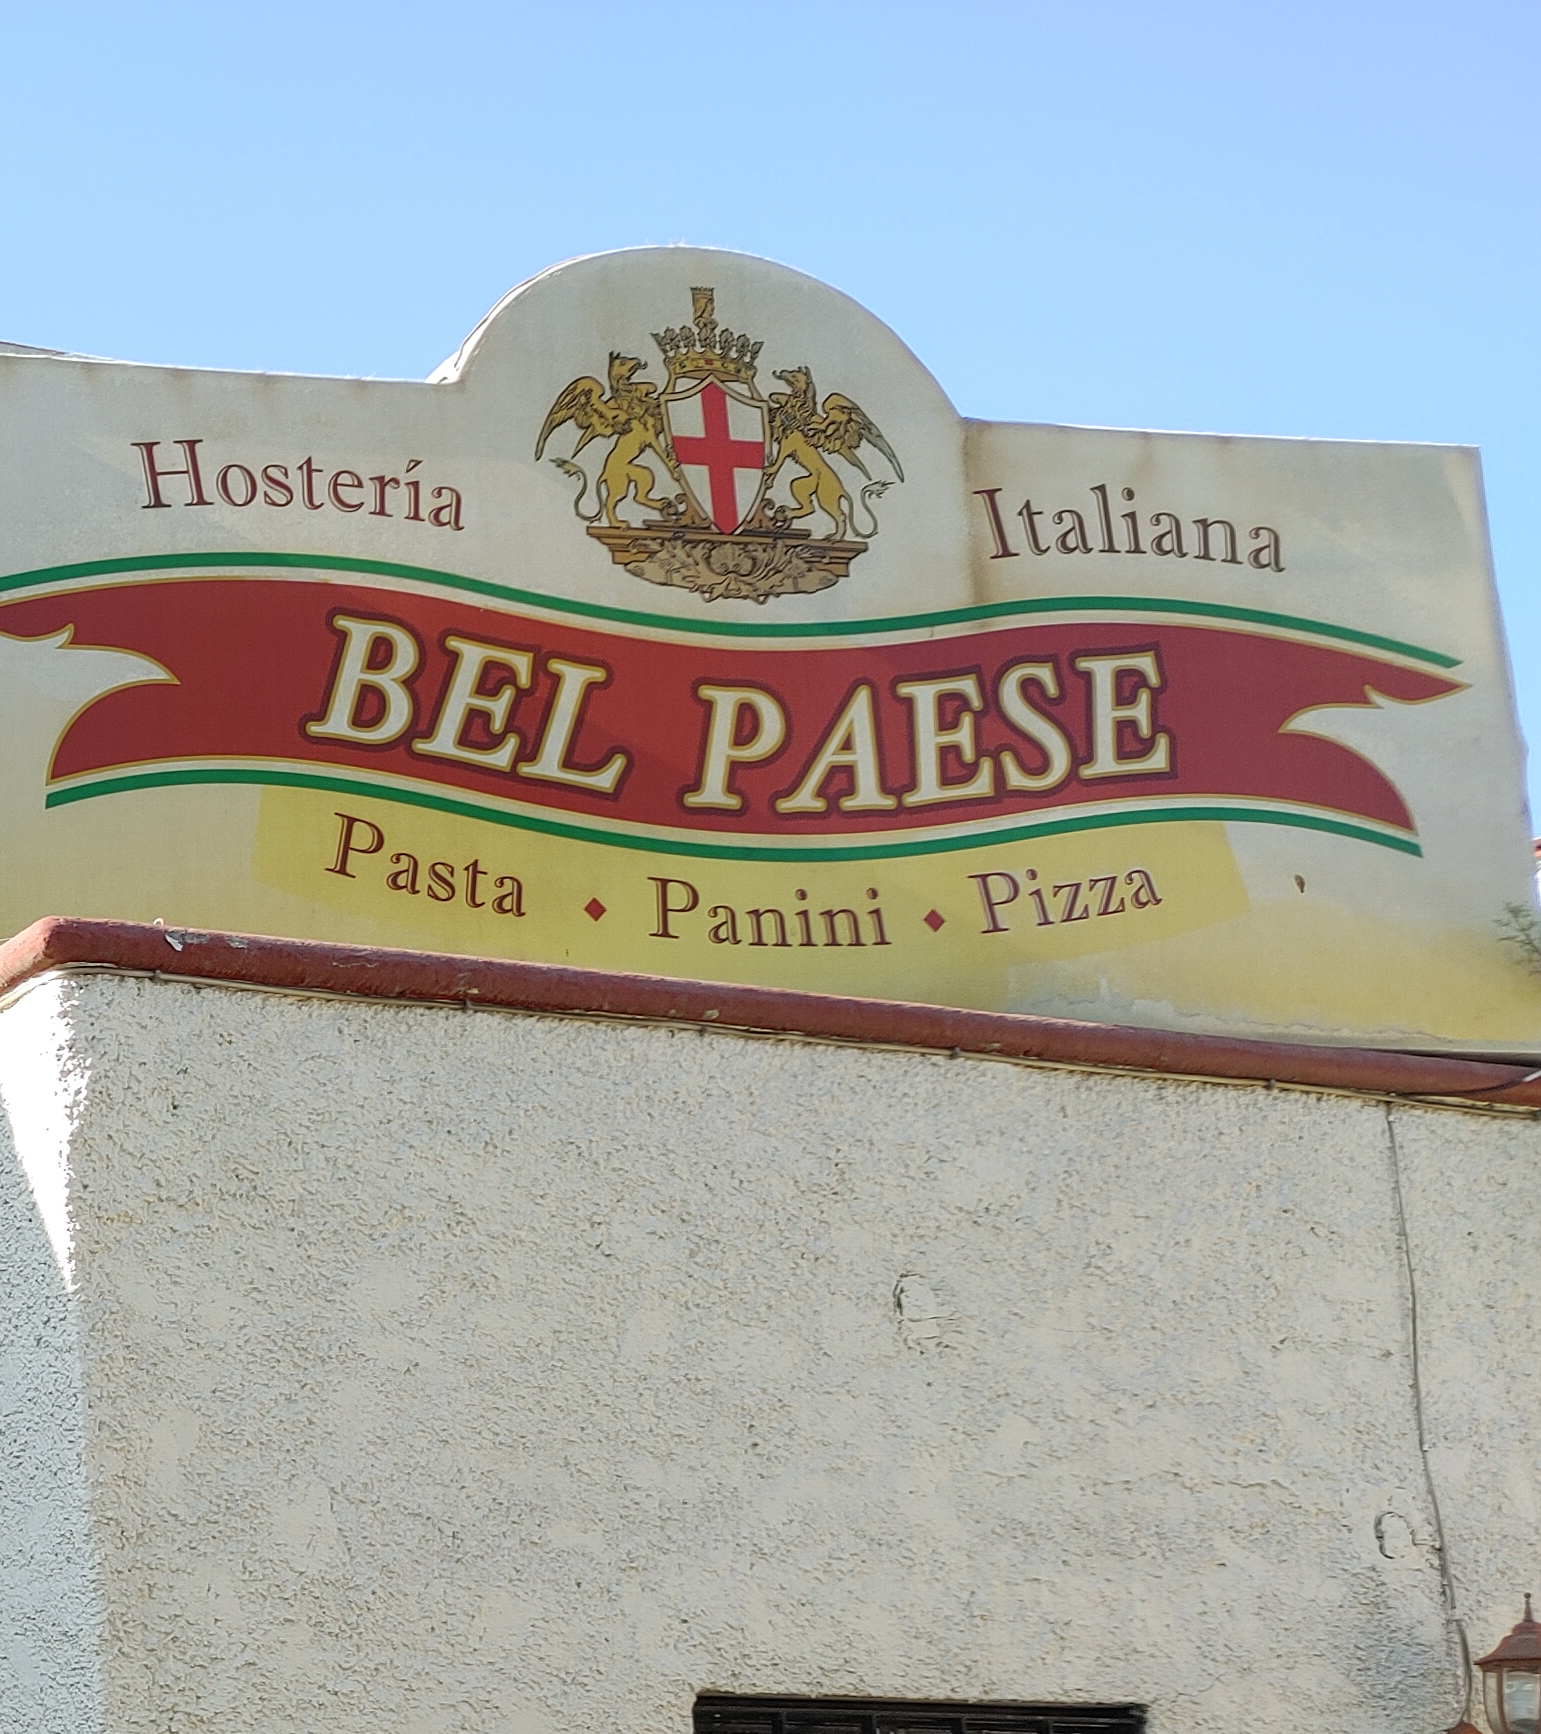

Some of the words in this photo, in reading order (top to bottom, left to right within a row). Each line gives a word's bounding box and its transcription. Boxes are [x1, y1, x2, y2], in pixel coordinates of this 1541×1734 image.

[130, 438, 466, 531] Hostería
[973, 484, 1286, 573] Italiana
[304, 609, 631, 798] BEL
[679, 647, 1175, 816] PAESE
[325, 812, 526, 918] Pasta
[649, 875, 892, 948] Panini
[968, 866, 1163, 935] Pizza
